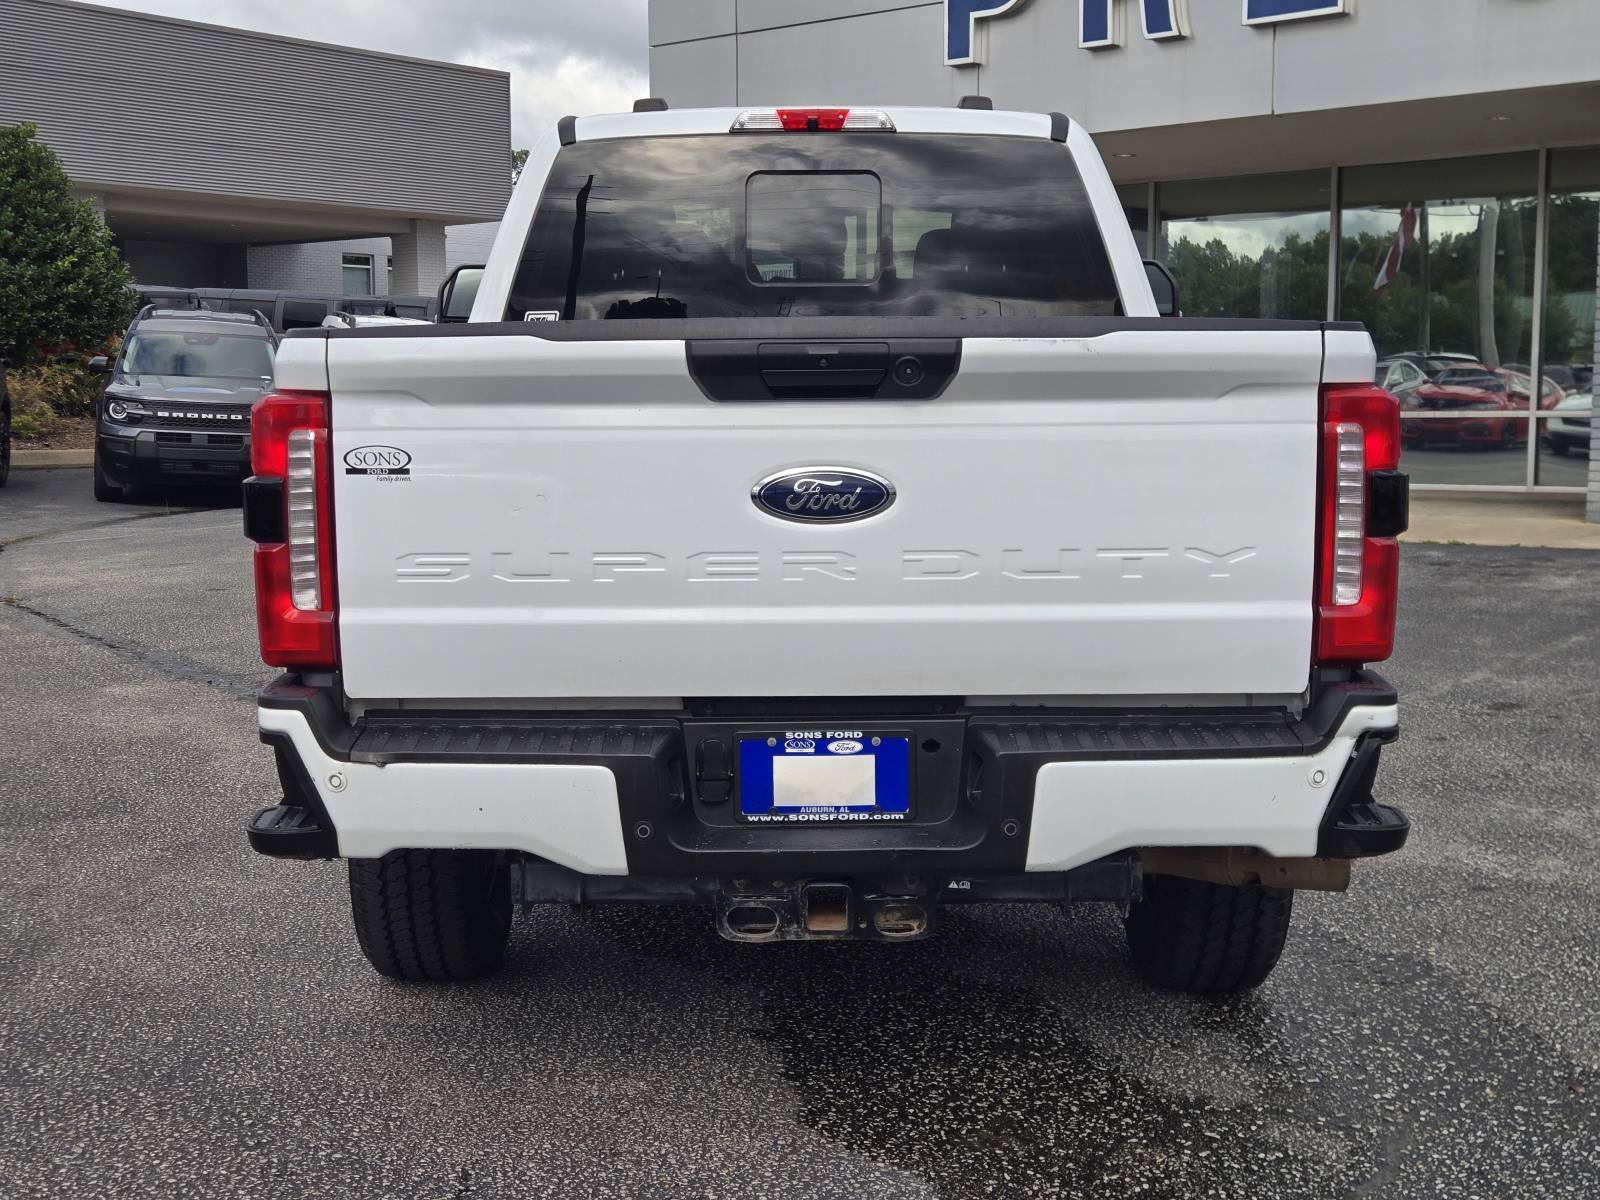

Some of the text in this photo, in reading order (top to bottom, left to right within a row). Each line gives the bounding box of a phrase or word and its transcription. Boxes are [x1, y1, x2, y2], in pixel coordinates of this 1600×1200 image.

[157, 411, 243, 420] BRONCO
[353, 451, 401, 466] SONS
[376, 475, 393, 483] Family
[785, 478, 863, 511] Ford
[396, 546, 1257, 583] SUPER DUTY
[785, 731, 863, 739] SONS FORD
[788, 740, 811, 749] SONS
[833, 742, 857, 752] Ford
[747, 813, 904, 822] www.SONSFORD.com
